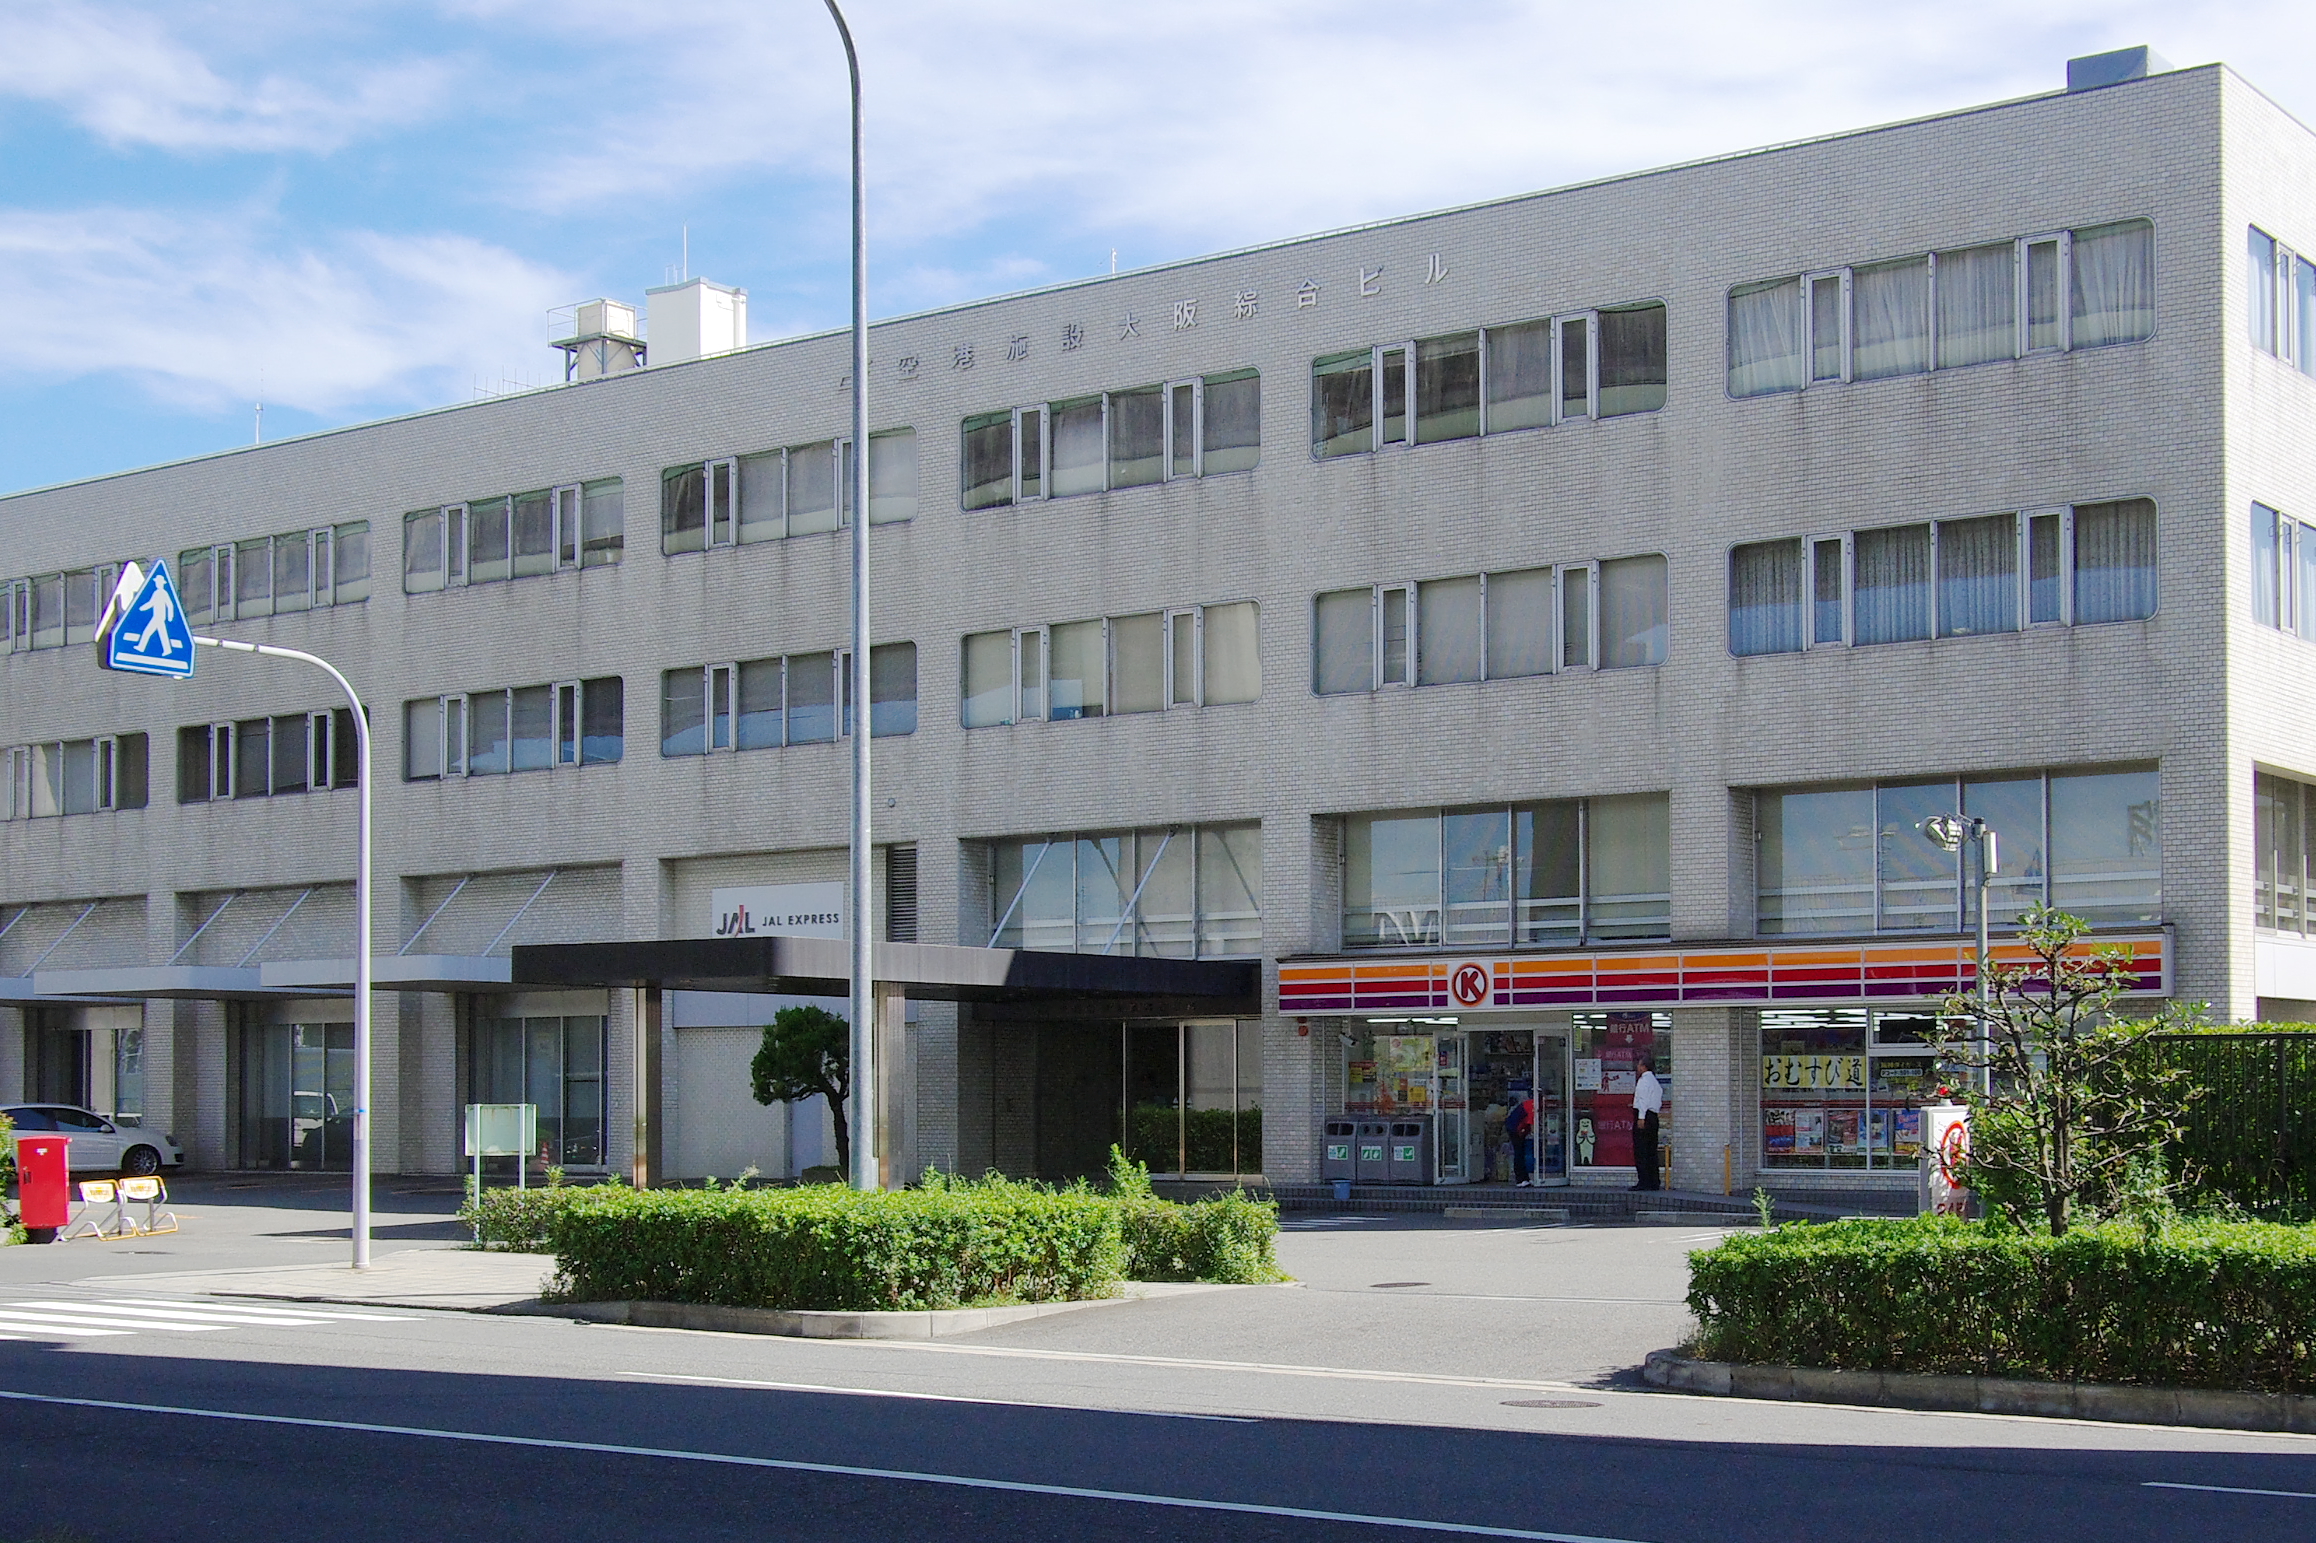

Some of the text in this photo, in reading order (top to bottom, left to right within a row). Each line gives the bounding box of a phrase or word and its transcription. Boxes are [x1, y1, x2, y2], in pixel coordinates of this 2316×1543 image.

[716, 904, 840, 938] JAL JAL EXPRESS
[1609, 1023, 1650, 1034] 銀行ATM
[1765, 1057, 1863, 1087] おむすび道
